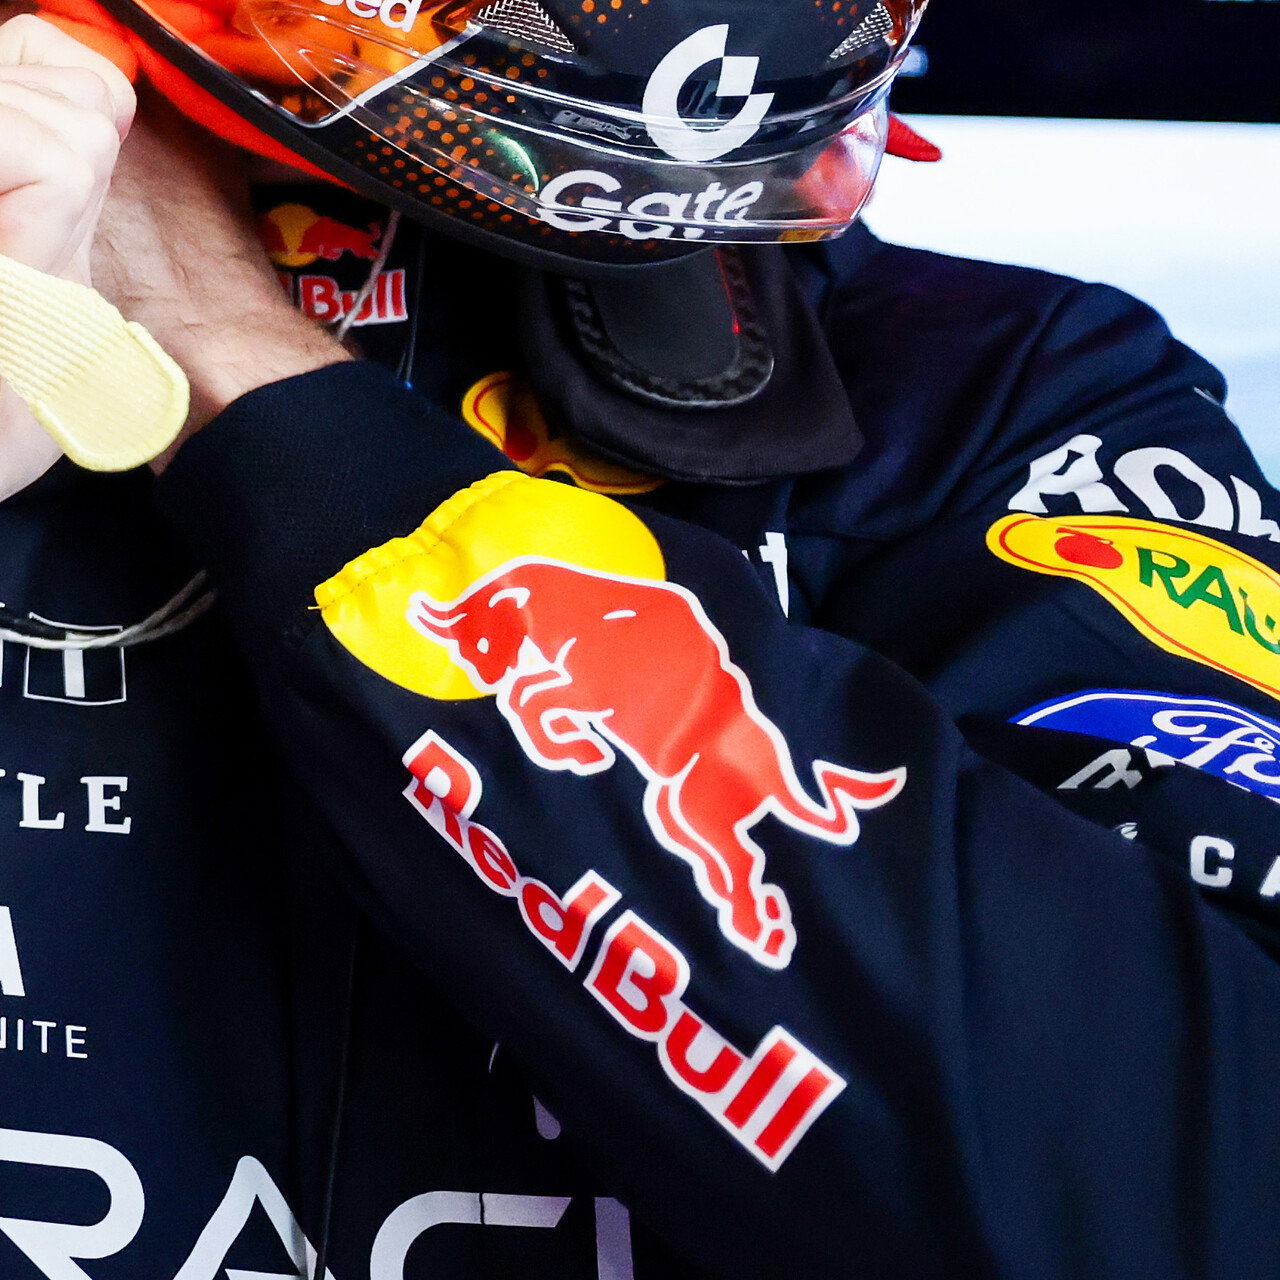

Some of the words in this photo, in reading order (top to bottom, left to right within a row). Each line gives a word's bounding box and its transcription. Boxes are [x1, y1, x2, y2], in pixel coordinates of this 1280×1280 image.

[536, 170, 764, 239] Gate
[298, 269, 408, 326] Bull
[402, 728, 621, 973] Red
[583, 909, 849, 1173] Bull
